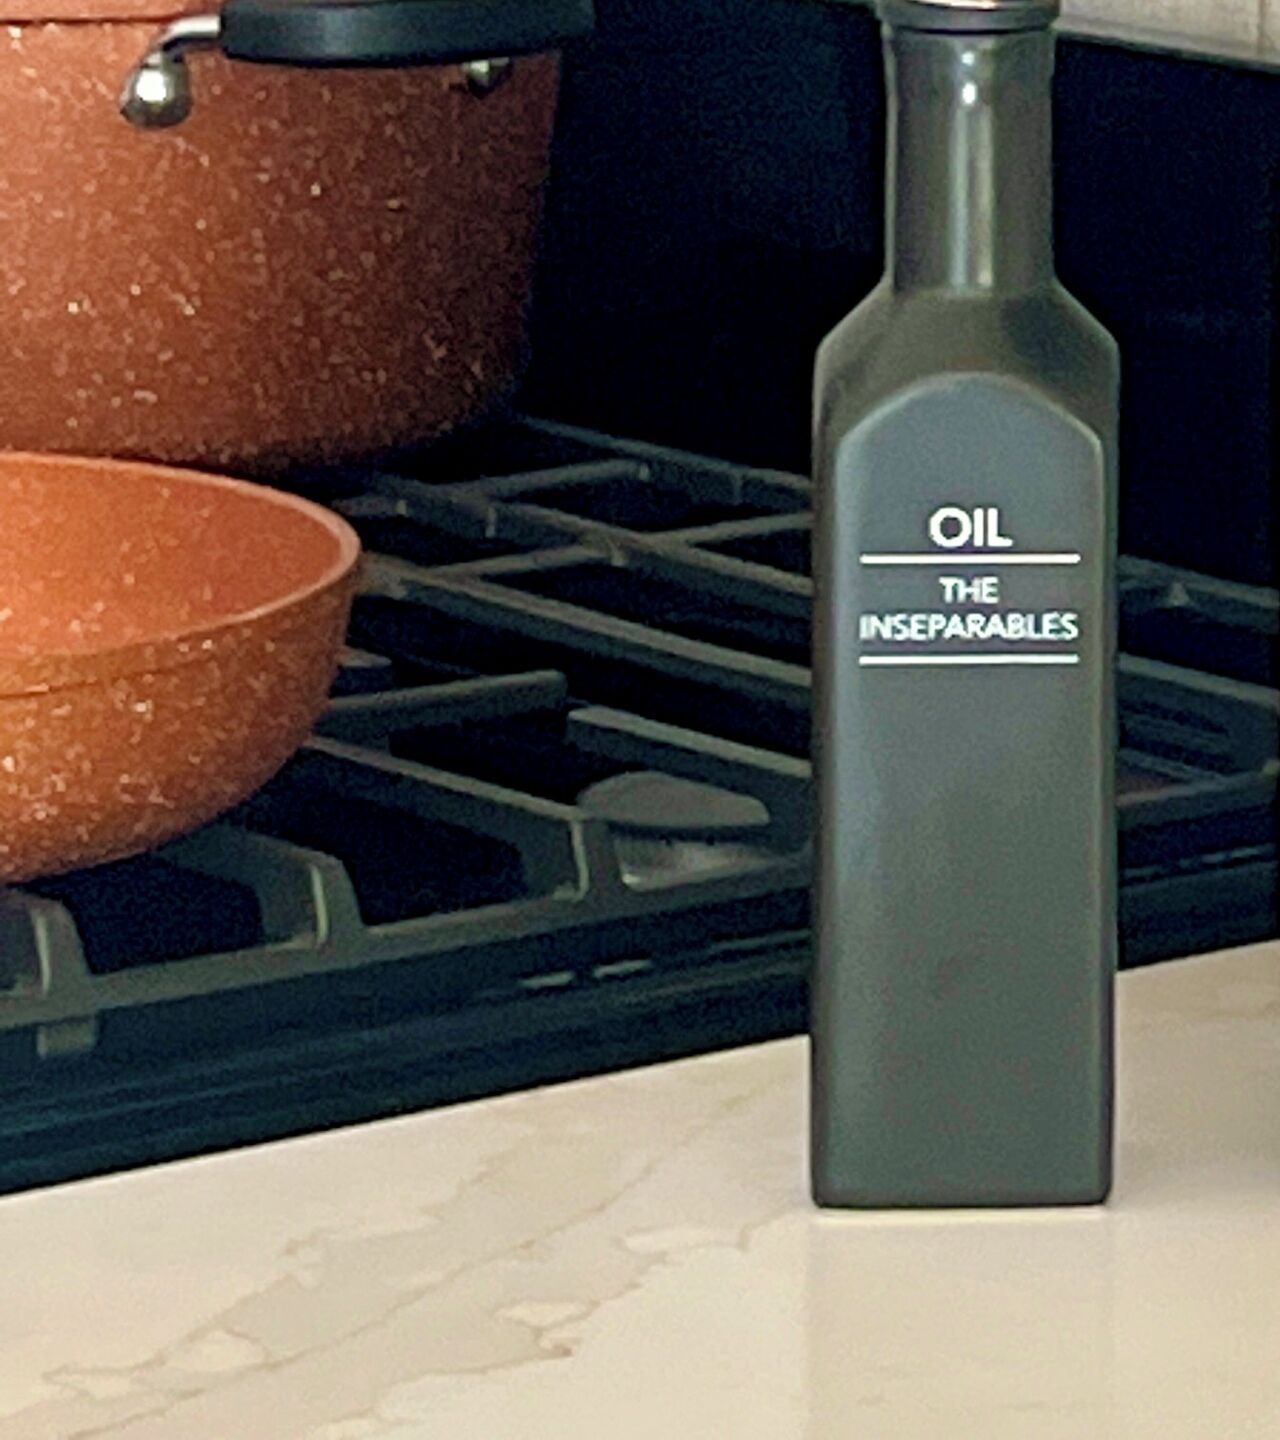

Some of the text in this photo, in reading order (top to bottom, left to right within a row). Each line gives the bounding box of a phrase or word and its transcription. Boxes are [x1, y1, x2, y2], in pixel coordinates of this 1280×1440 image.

[929, 507, 1014, 548] OIL
[939, 576, 999, 603] THE
[859, 612, 1079, 641] INSEPARABLES
